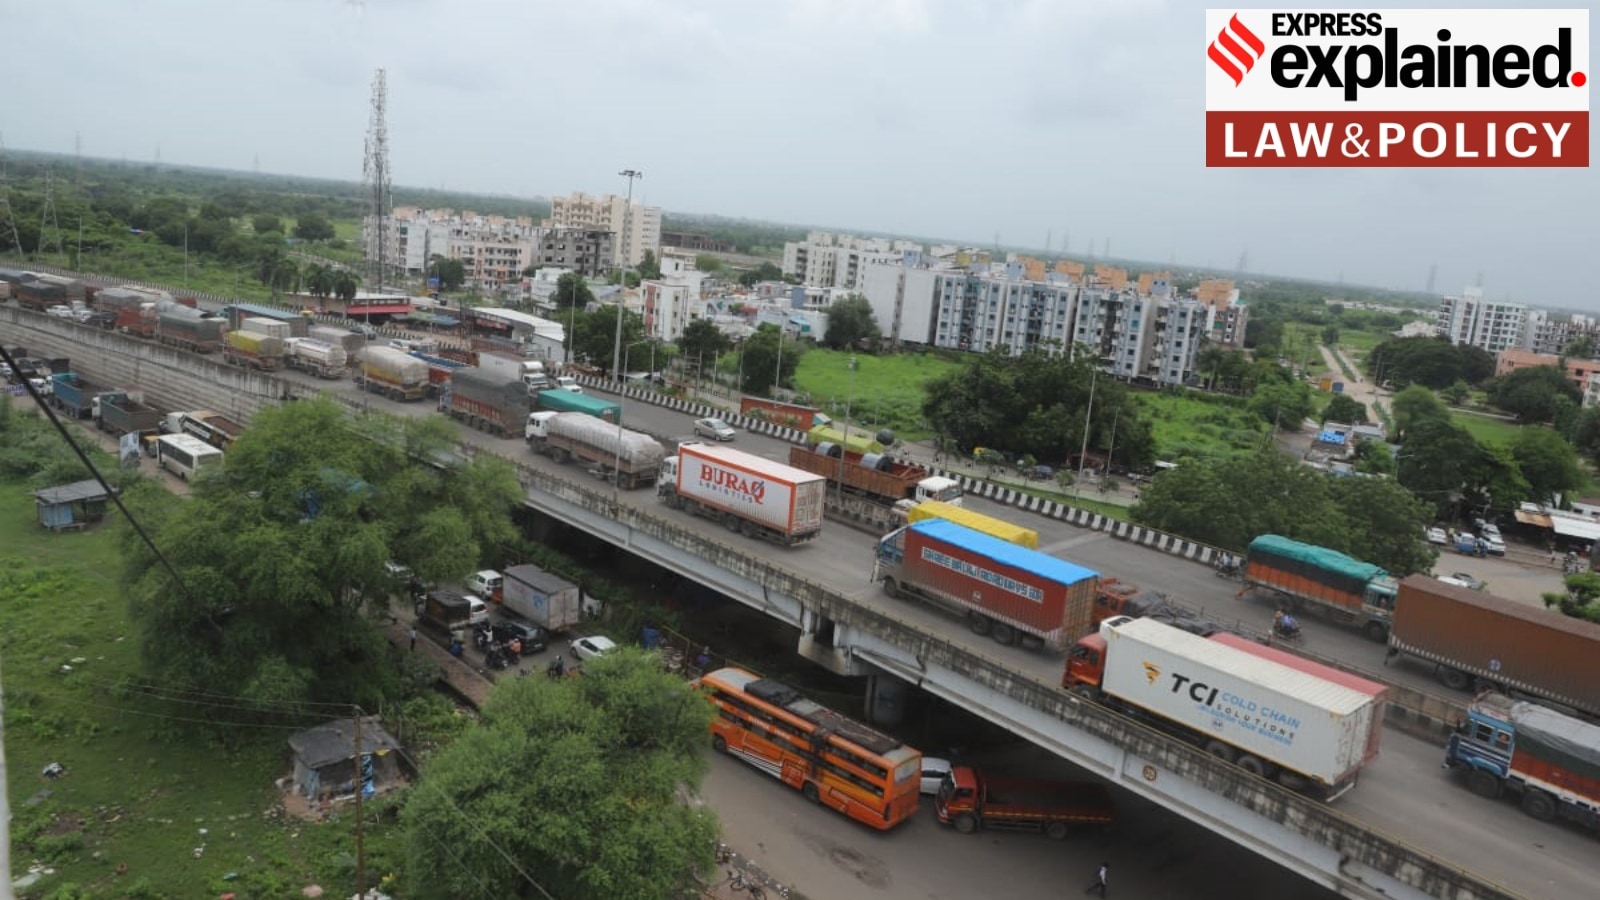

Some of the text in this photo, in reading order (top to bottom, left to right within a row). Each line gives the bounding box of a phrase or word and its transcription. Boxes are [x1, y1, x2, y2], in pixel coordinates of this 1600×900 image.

[701, 463, 765, 505] BURAQ
[1172, 673, 1219, 706] TCI
[1217, 703, 1295, 739] SOLUTIONS
[1222, 692, 1257, 712] COLD
[1260, 706, 1301, 729] CHAIN
